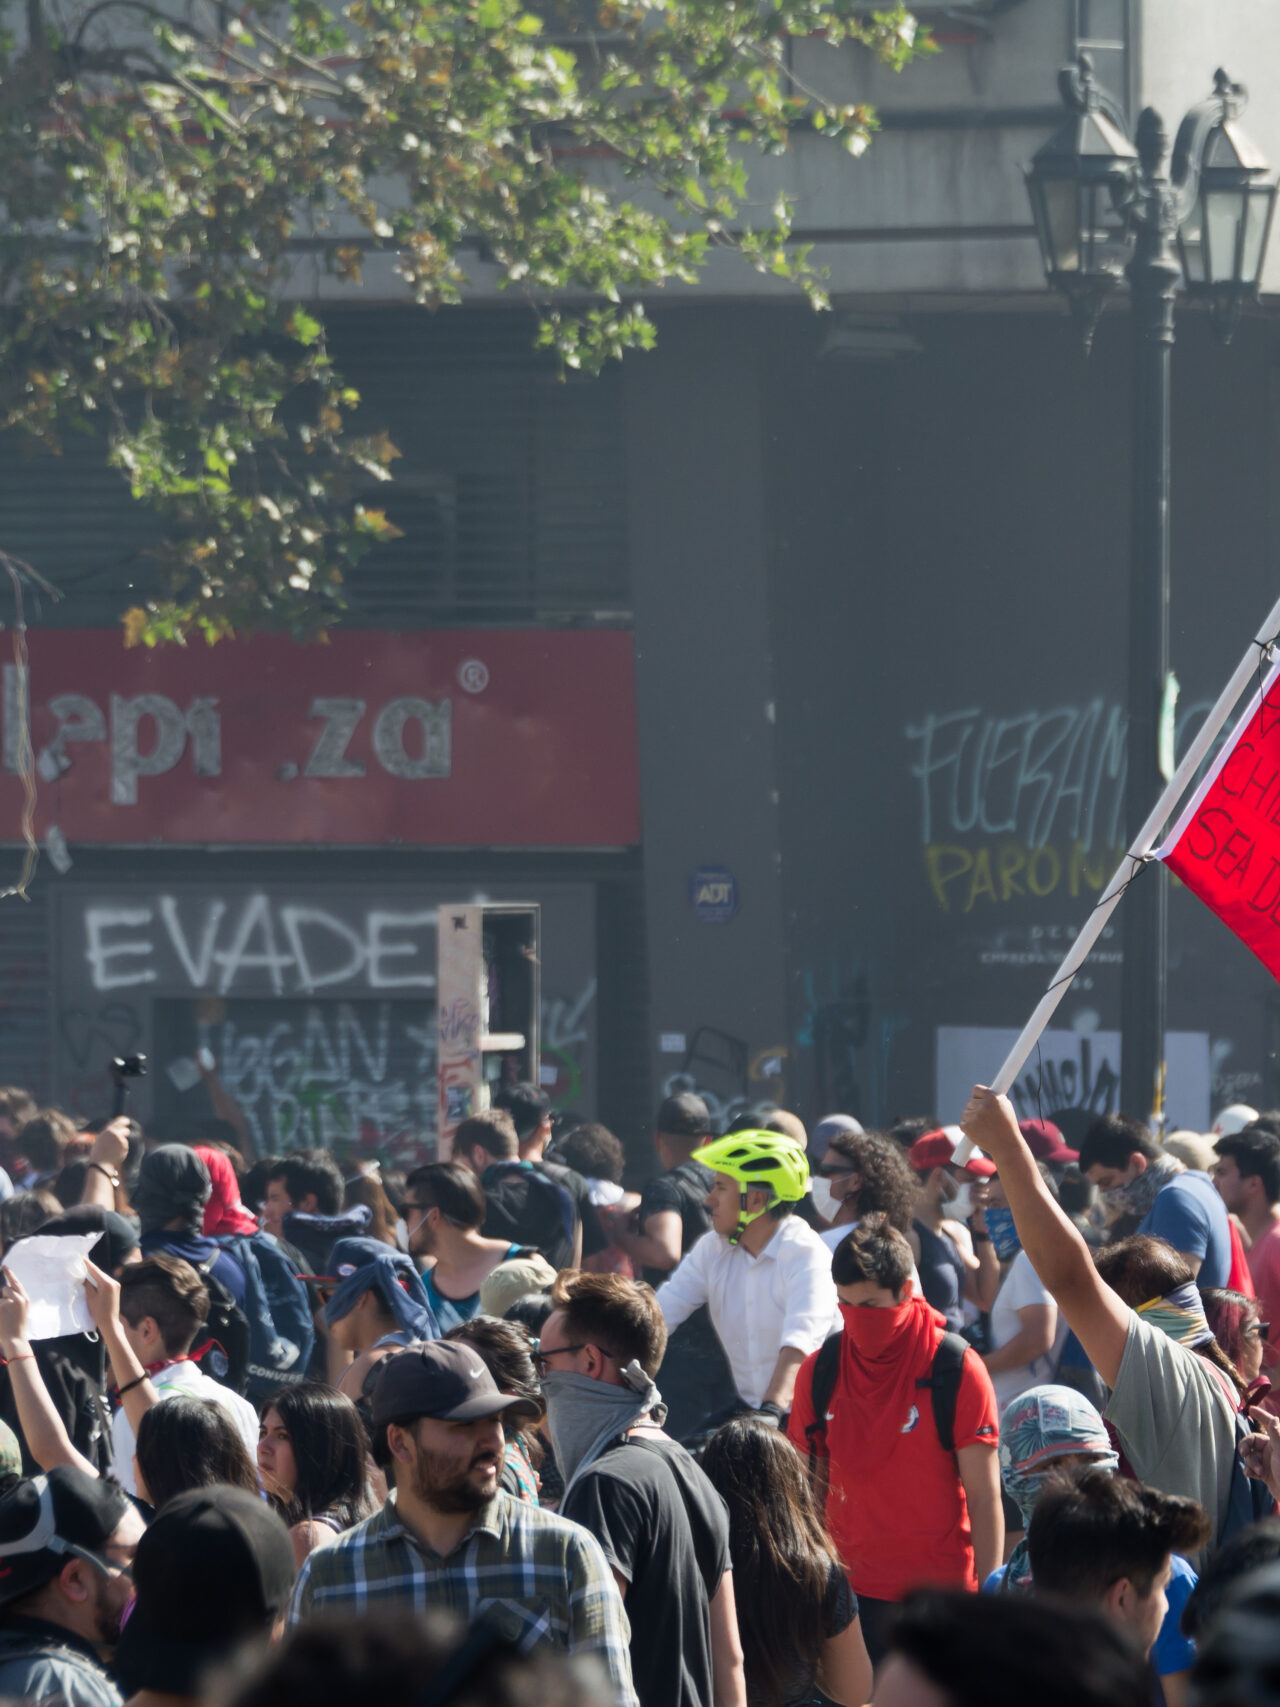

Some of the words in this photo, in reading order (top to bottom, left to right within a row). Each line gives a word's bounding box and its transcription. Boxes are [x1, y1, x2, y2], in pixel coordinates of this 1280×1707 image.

[1187, 807, 1257, 890] SEA
[696, 882, 733, 904] ADT
[86, 895, 439, 995] EVADE
